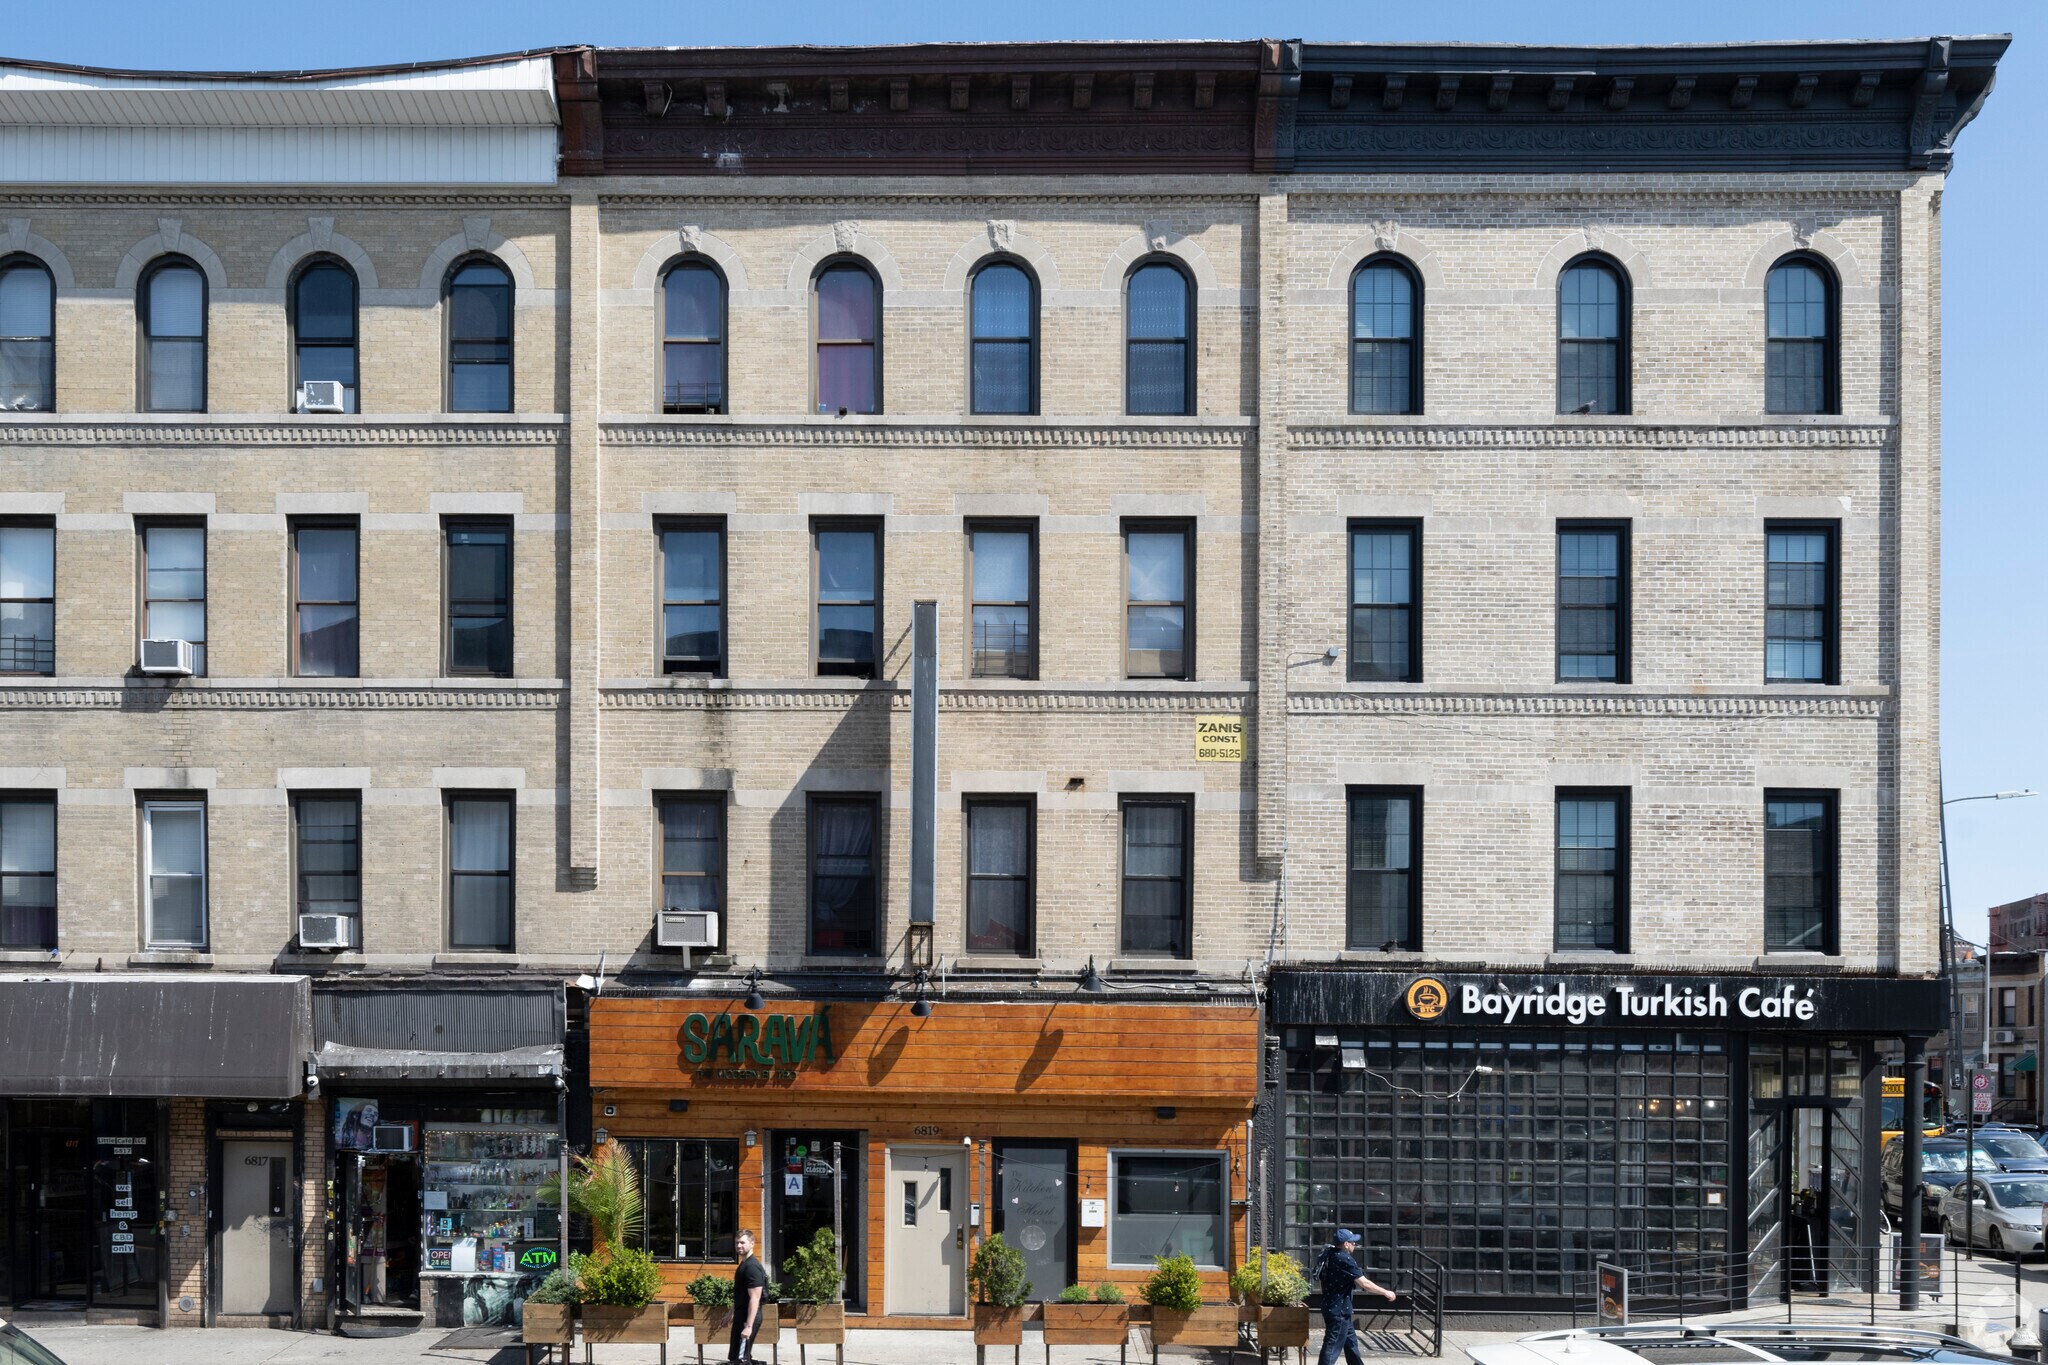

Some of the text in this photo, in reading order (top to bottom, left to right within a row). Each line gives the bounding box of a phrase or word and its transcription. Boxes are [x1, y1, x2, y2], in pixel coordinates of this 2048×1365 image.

[1198, 723, 1242, 733] ZANIS
[1202, 735, 1238, 743] CONST.
[1199, 748, 1241, 758] 680-5125
[1462, 982, 1606, 1025] Bayridge
[1616, 983, 1728, 1017] Turkish
[1738, 985, 1815, 1020] Café
[683, 1005, 836, 1065] SARAVÁ
[914, 1126, 940, 1136] 6819
[244, 1156, 268, 1166] 6817
[788, 1177, 799, 1189] A
[116, 1198, 131, 1206] sell
[110, 1209, 137, 1219] hemp
[119, 1221, 128, 1230] &
[520, 1252, 556, 1263] ATM
